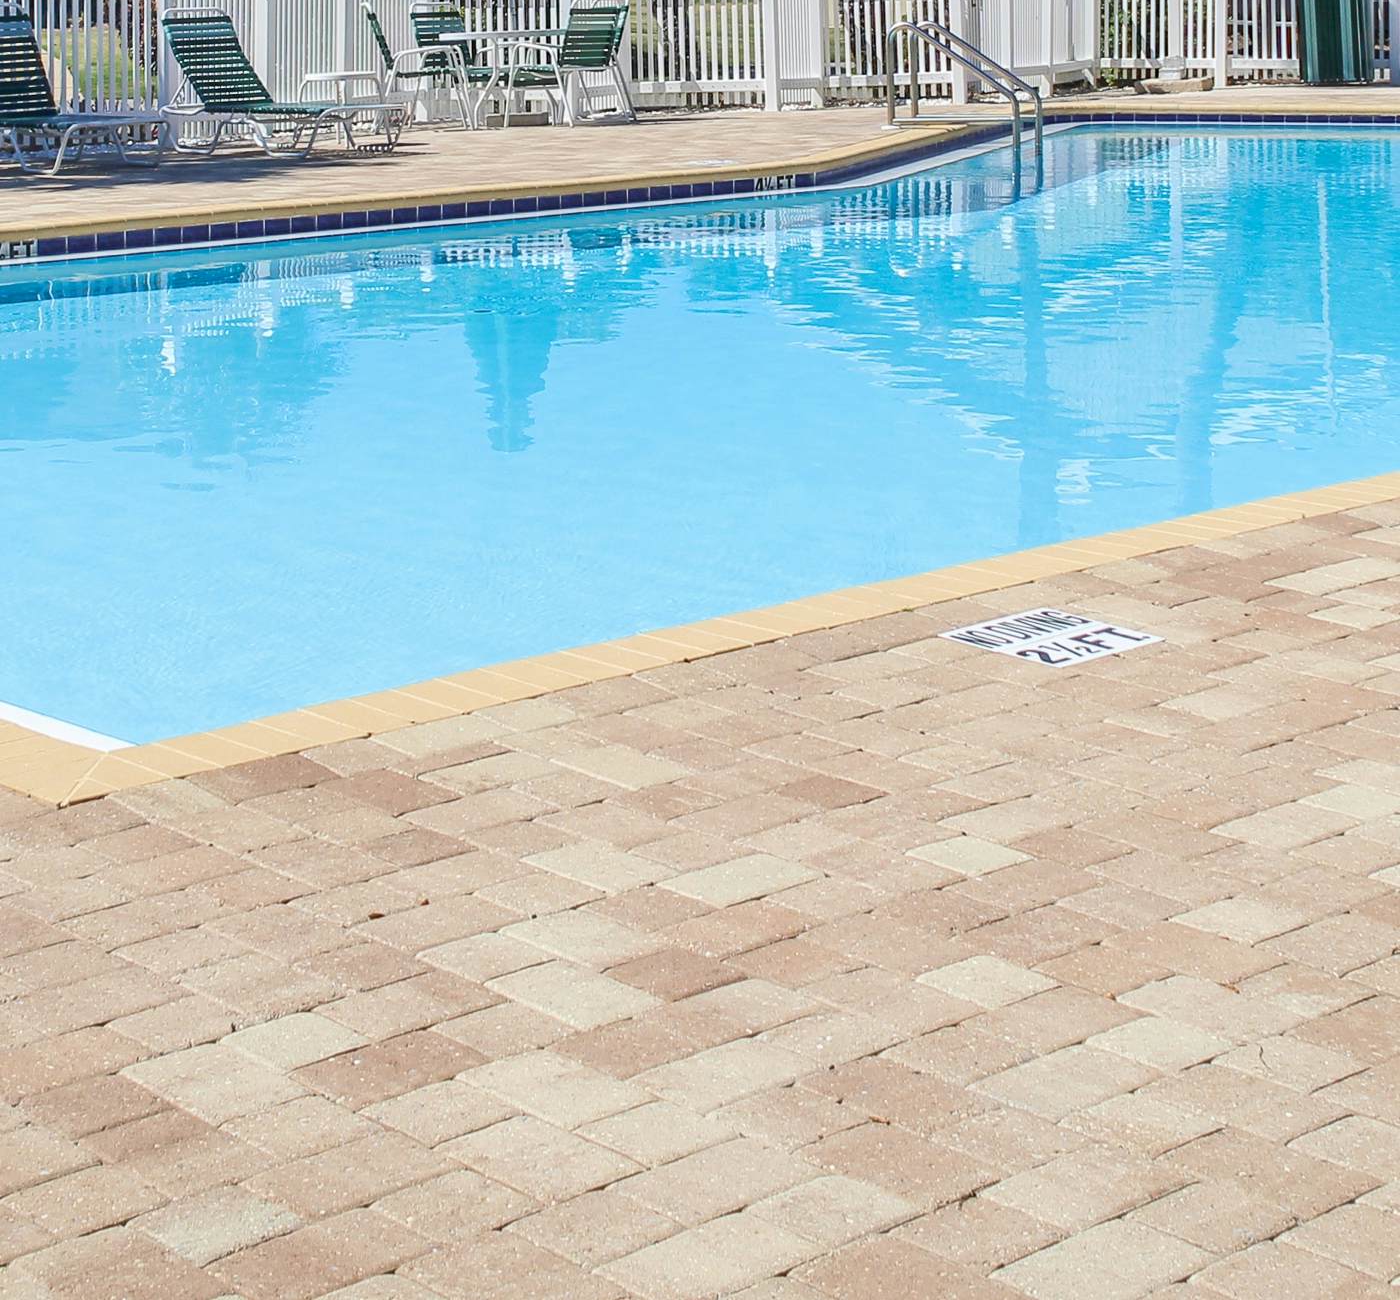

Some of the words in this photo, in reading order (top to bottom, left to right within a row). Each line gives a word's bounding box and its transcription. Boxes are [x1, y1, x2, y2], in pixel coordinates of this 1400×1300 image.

[776, 174, 794, 190] FT
[981, 610, 1092, 640] DIVING
[950, 630, 1013, 649] NO
